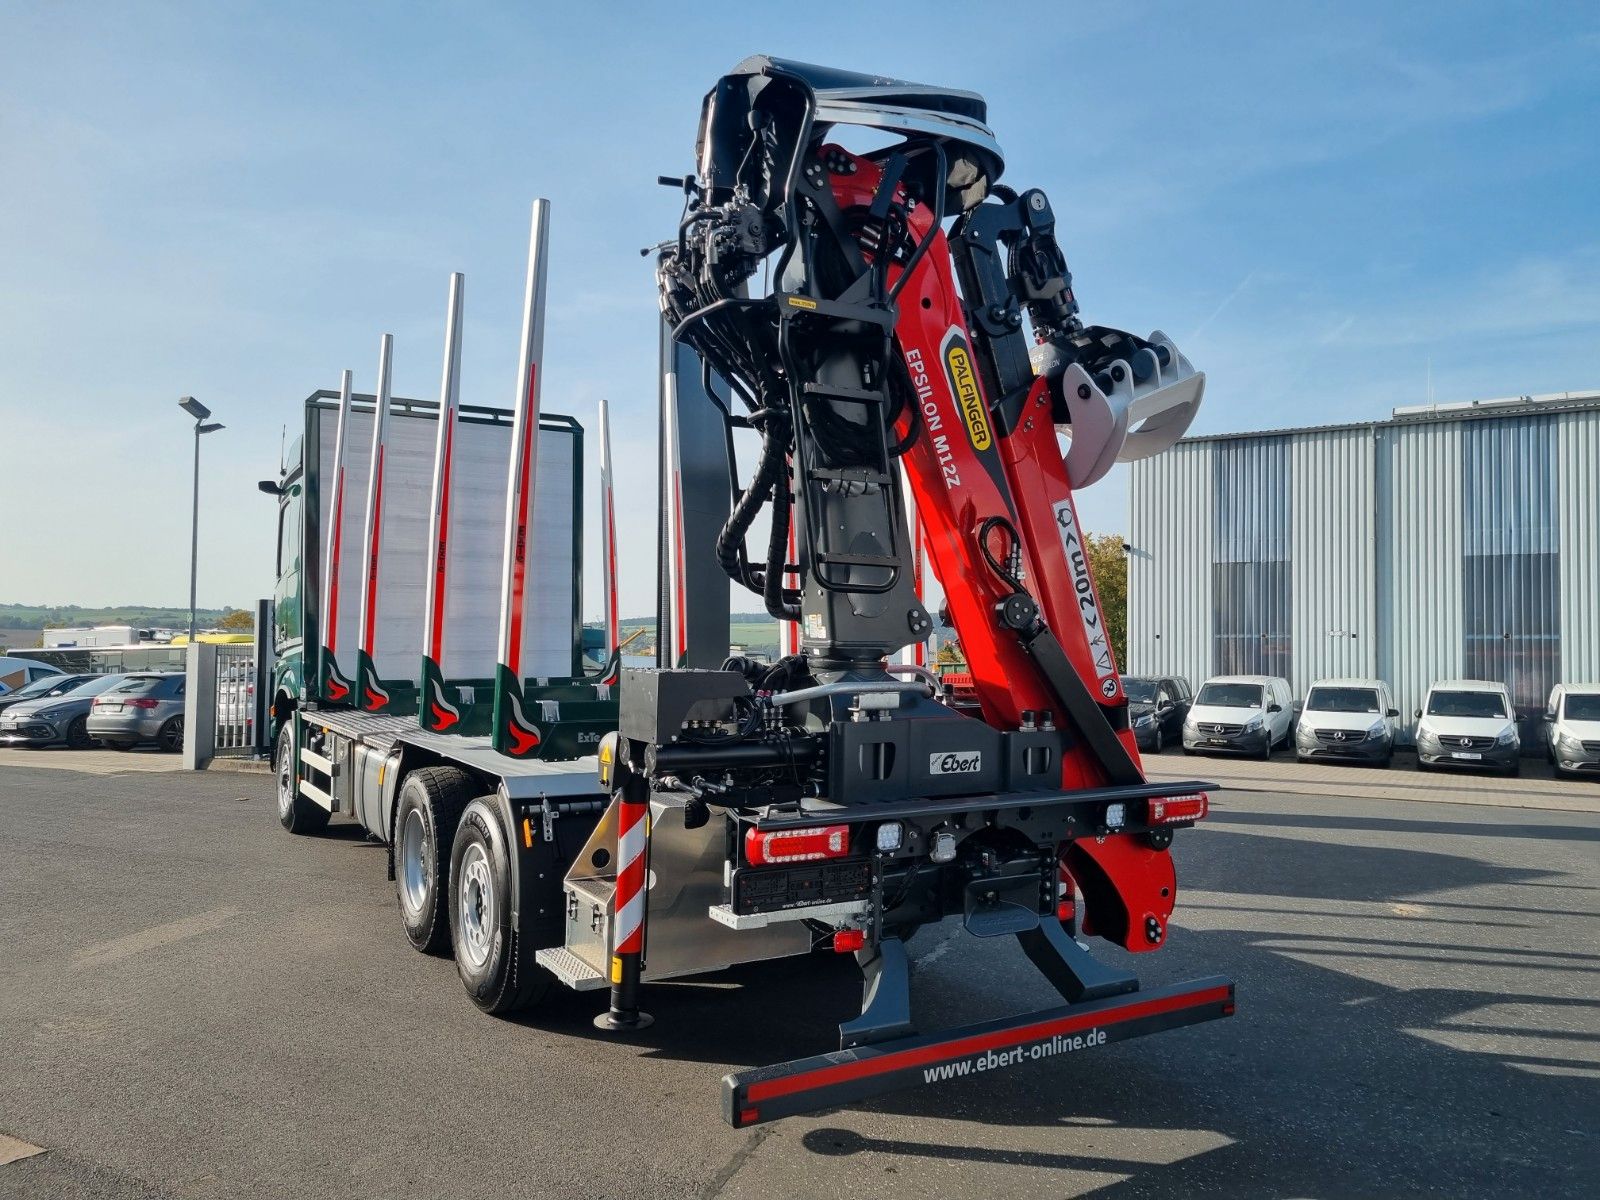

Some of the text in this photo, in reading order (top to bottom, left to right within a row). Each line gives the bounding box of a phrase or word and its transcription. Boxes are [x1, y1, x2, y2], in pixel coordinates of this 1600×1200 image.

[906, 349, 961, 489] EPSILON M12Z
[952, 353, 987, 444] PALFINGER
[1071, 551, 1095, 610] 20m
[941, 754, 979, 772] Ebert
[923, 1027, 1107, 1084] www.ebert-online.de
